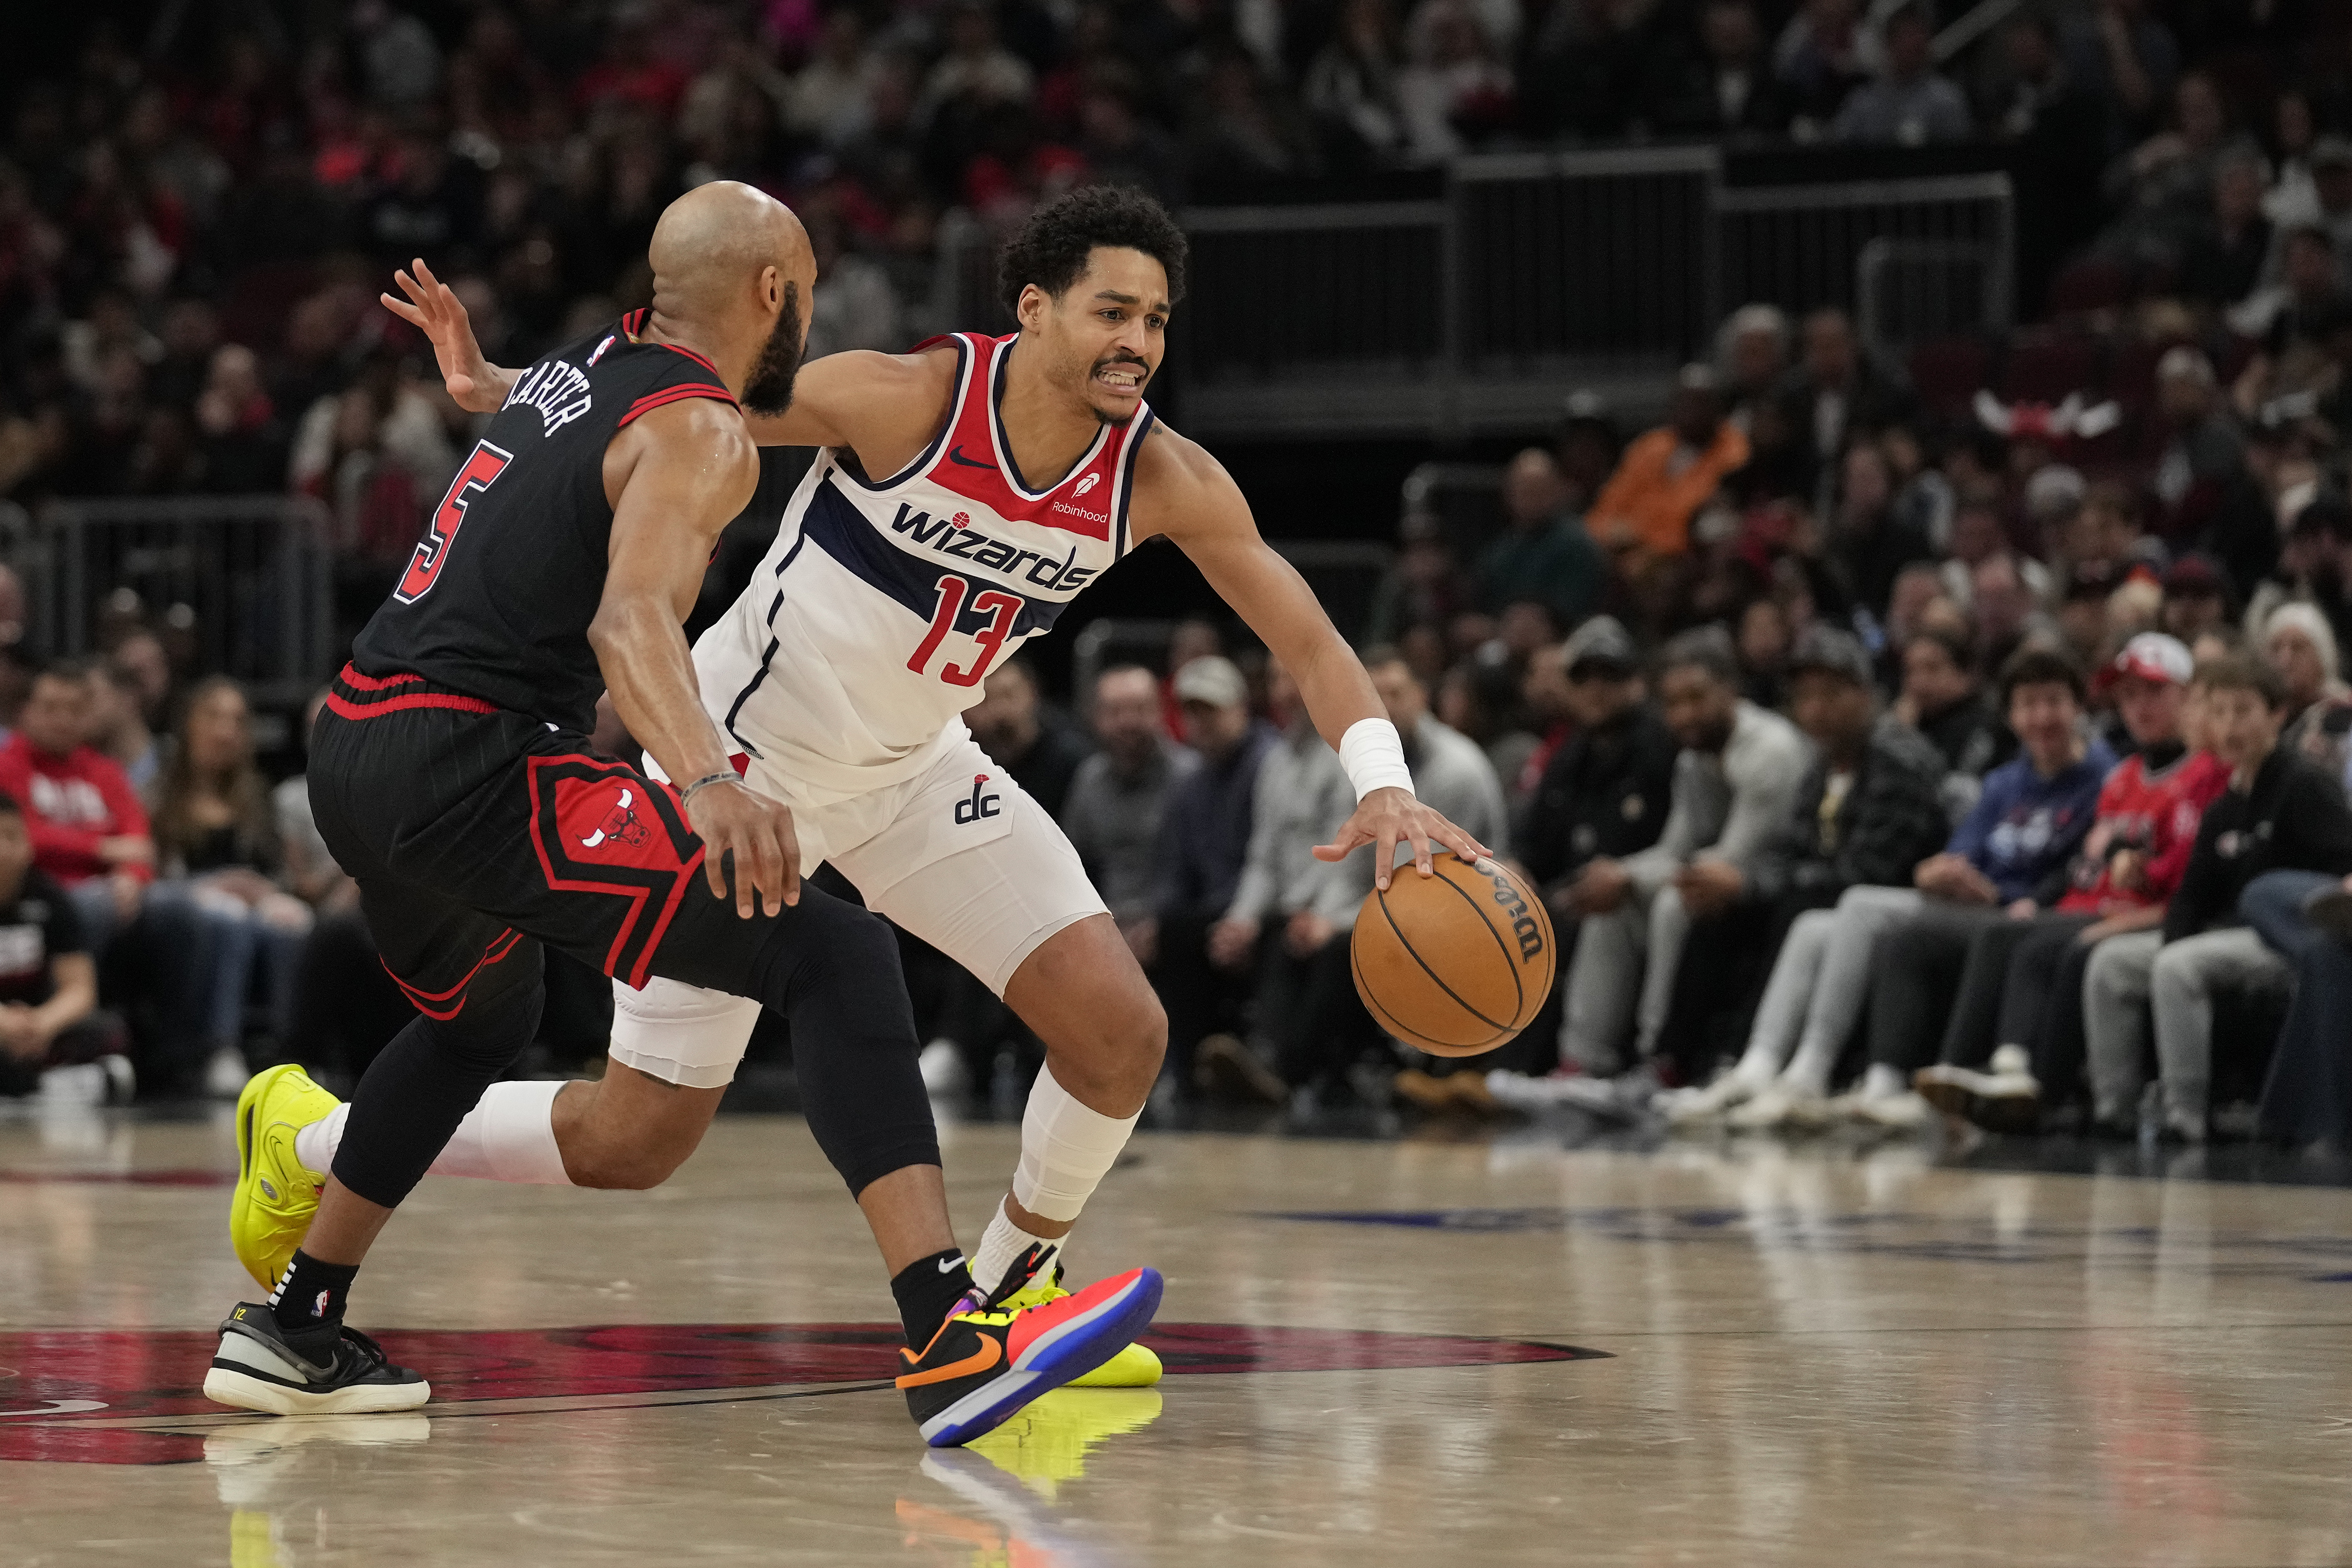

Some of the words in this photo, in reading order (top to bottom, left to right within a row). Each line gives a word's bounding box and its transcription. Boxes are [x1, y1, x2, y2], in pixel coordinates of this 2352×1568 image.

[501, 360, 592, 438] CARTER
[393, 438, 514, 605] 5
[1052, 501, 1108, 524] Robinhood
[905, 576, 1024, 688] 13
[955, 781, 1000, 825] dc
[233, 1307, 247, 1320] 12
